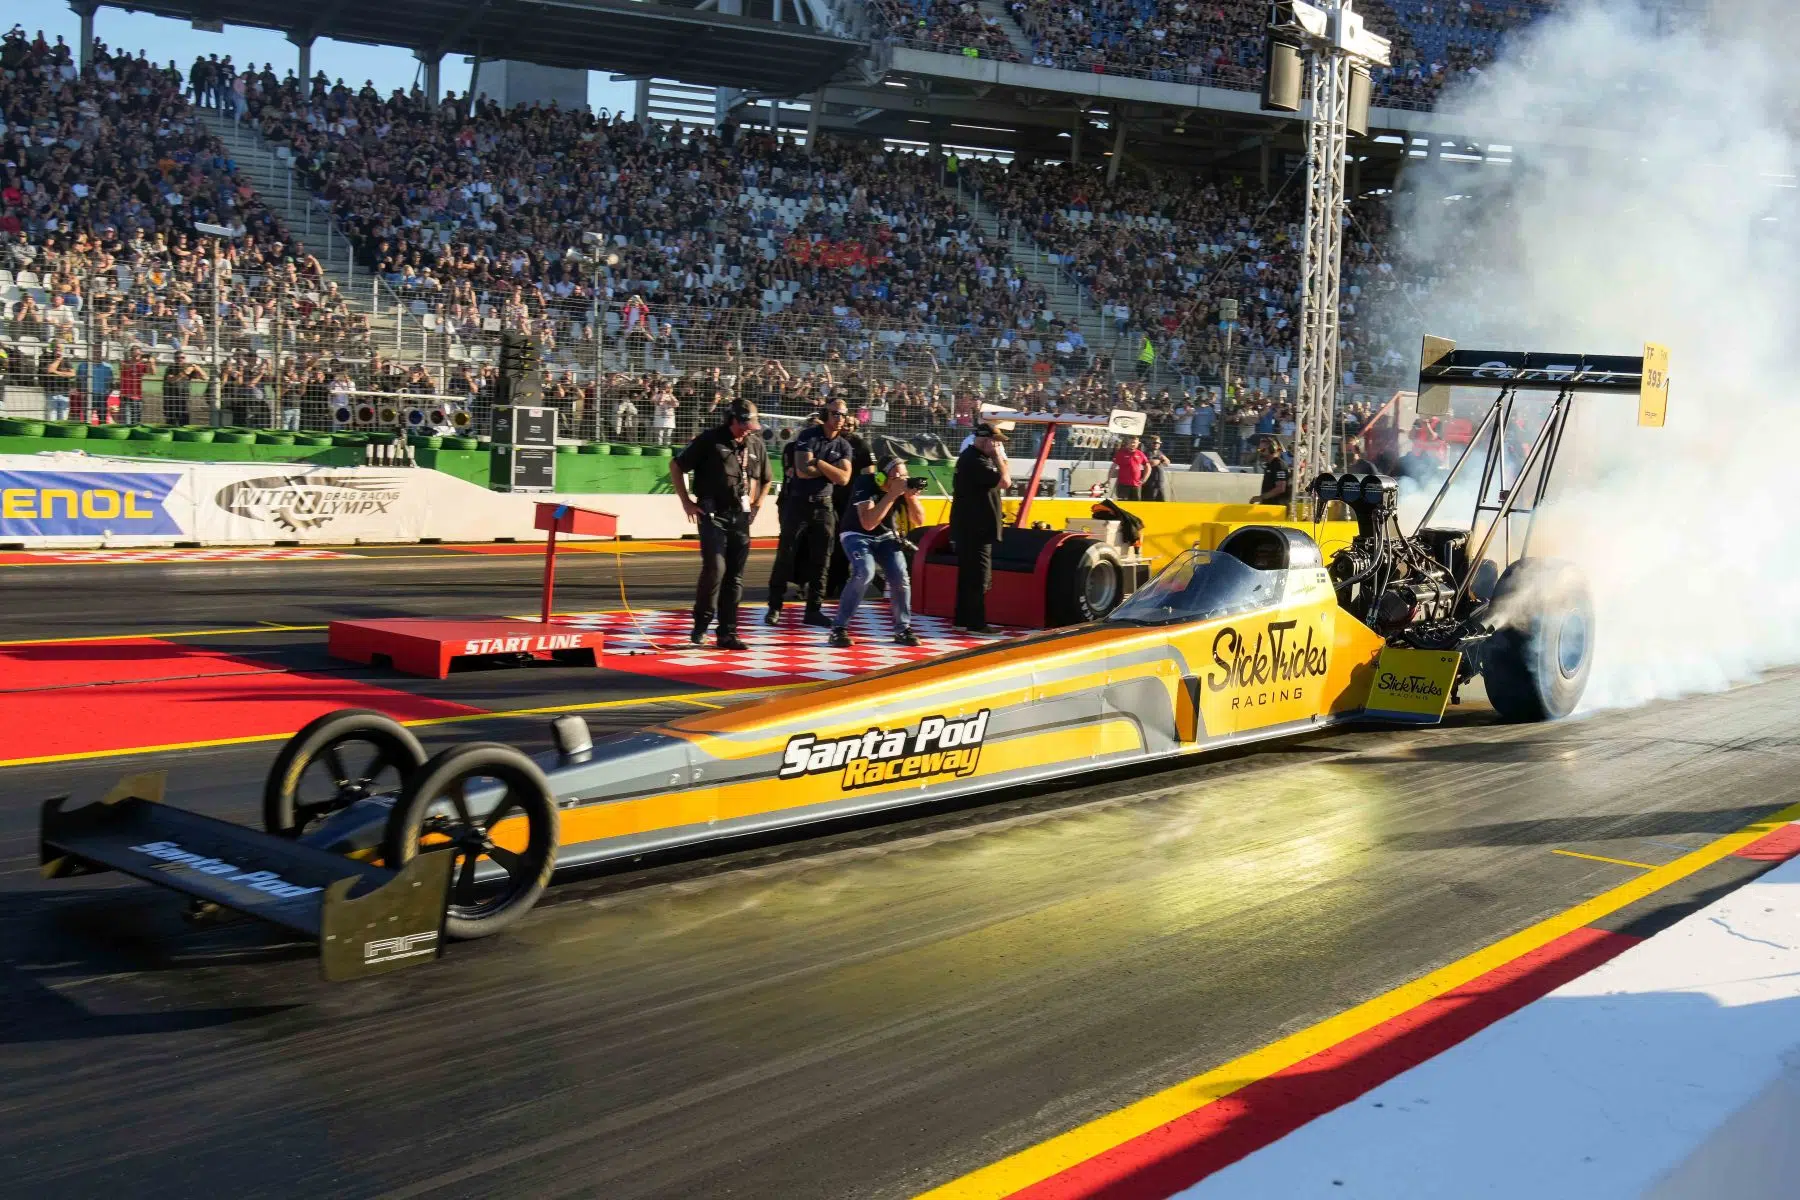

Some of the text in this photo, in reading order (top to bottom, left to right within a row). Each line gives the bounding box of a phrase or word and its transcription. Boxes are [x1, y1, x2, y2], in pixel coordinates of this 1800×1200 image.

[1646, 368, 1662, 389] 393
[0, 488, 154, 519] ENOL
[324, 490, 400, 501] DRAG RACING
[464, 634, 583, 655] START LINE
[1231, 687, 1303, 710] RACING
[779, 709, 990, 779] Santa Pod
[842, 747, 982, 790] Raceway
[128, 841, 325, 898] Santa Pod
